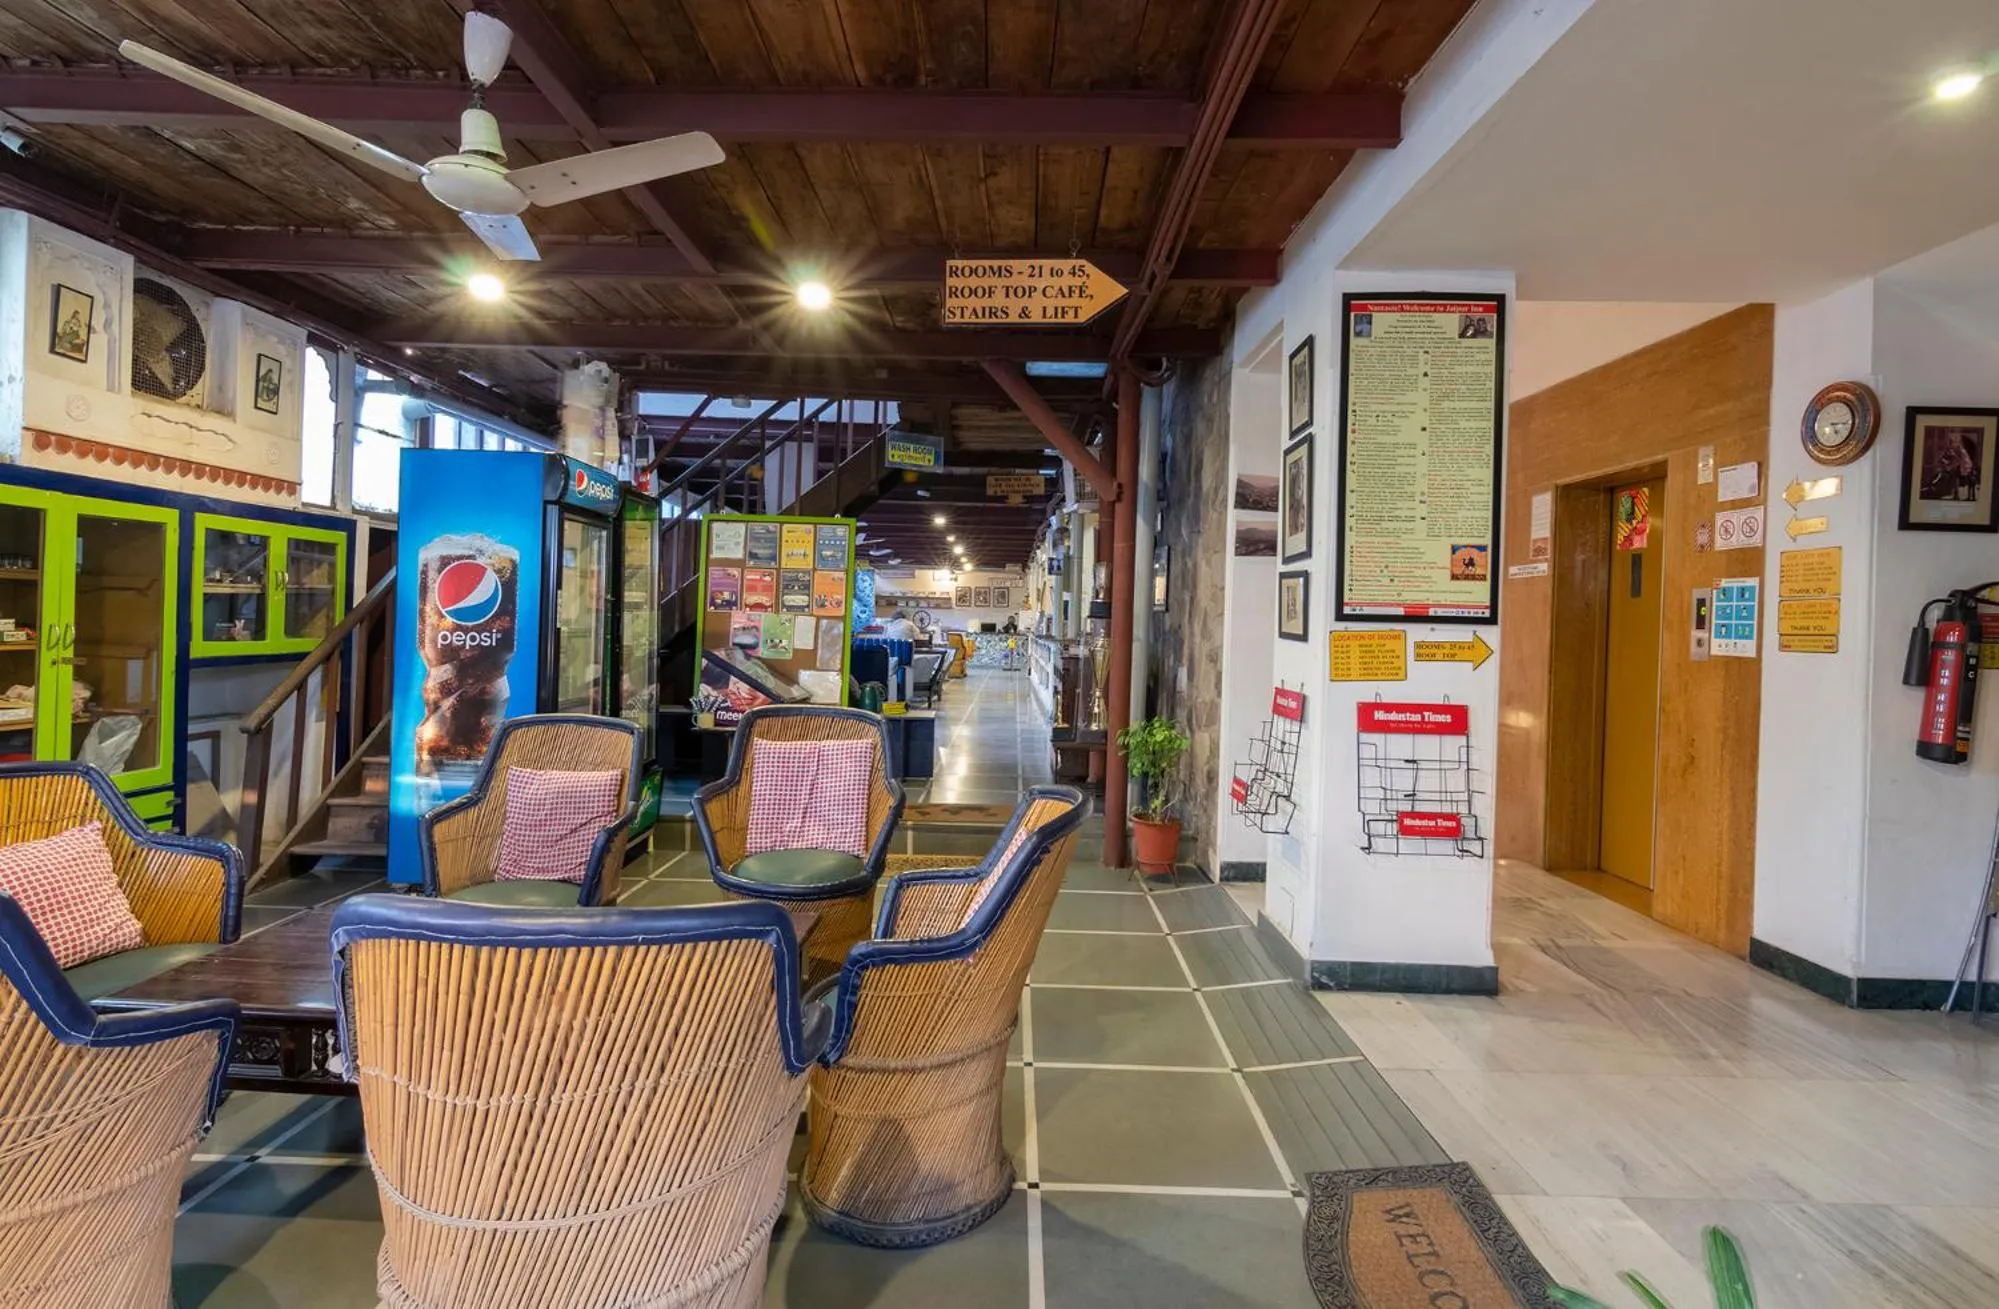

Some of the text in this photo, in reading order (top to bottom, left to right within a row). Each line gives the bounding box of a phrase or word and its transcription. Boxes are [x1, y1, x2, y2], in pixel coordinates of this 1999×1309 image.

[949, 265, 1013, 278] ROOMS
[1028, 265, 1043, 278] 21
[1050, 266, 1064, 278] to
[1068, 265, 1090, 280] 45,
[948, 282, 1094, 301] ROOF TOP CAFÉ,
[947, 306, 1082, 319] STAIRS & LIFT
[891, 443, 911, 453] WASH
[588, 481, 614, 501] pepsi
[437, 630, 497, 650] pepsi
[1374, 710, 1452, 723] Hindustan Times
